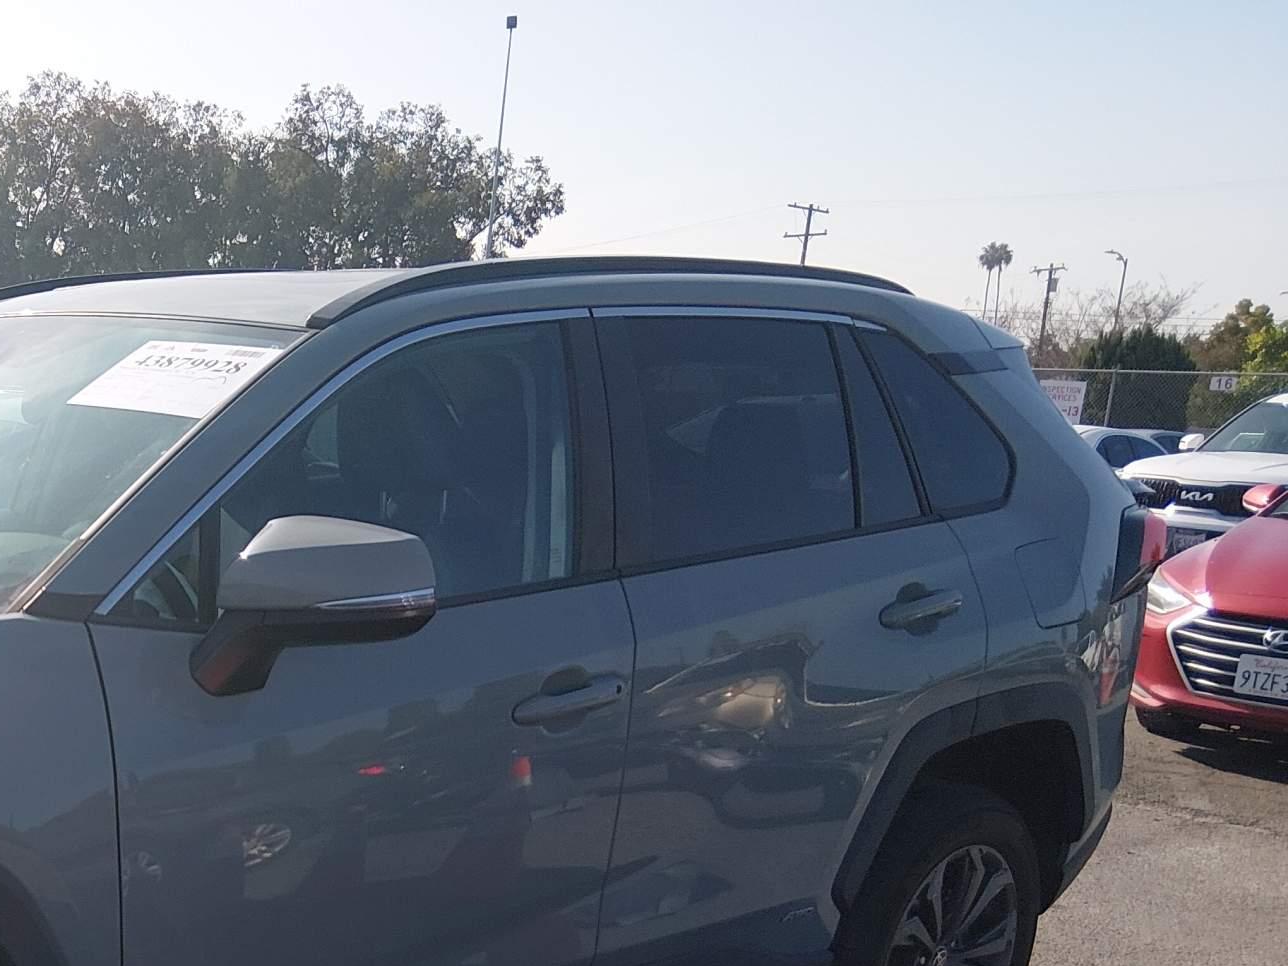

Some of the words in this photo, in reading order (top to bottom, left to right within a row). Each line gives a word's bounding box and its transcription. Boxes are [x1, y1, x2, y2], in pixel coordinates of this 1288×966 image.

[135, 354, 248, 375] 43879928
[1041, 385, 1082, 394] NSPECTION
[1216, 377, 1234, 390] 16
[1180, 490, 1215, 501] KIA
